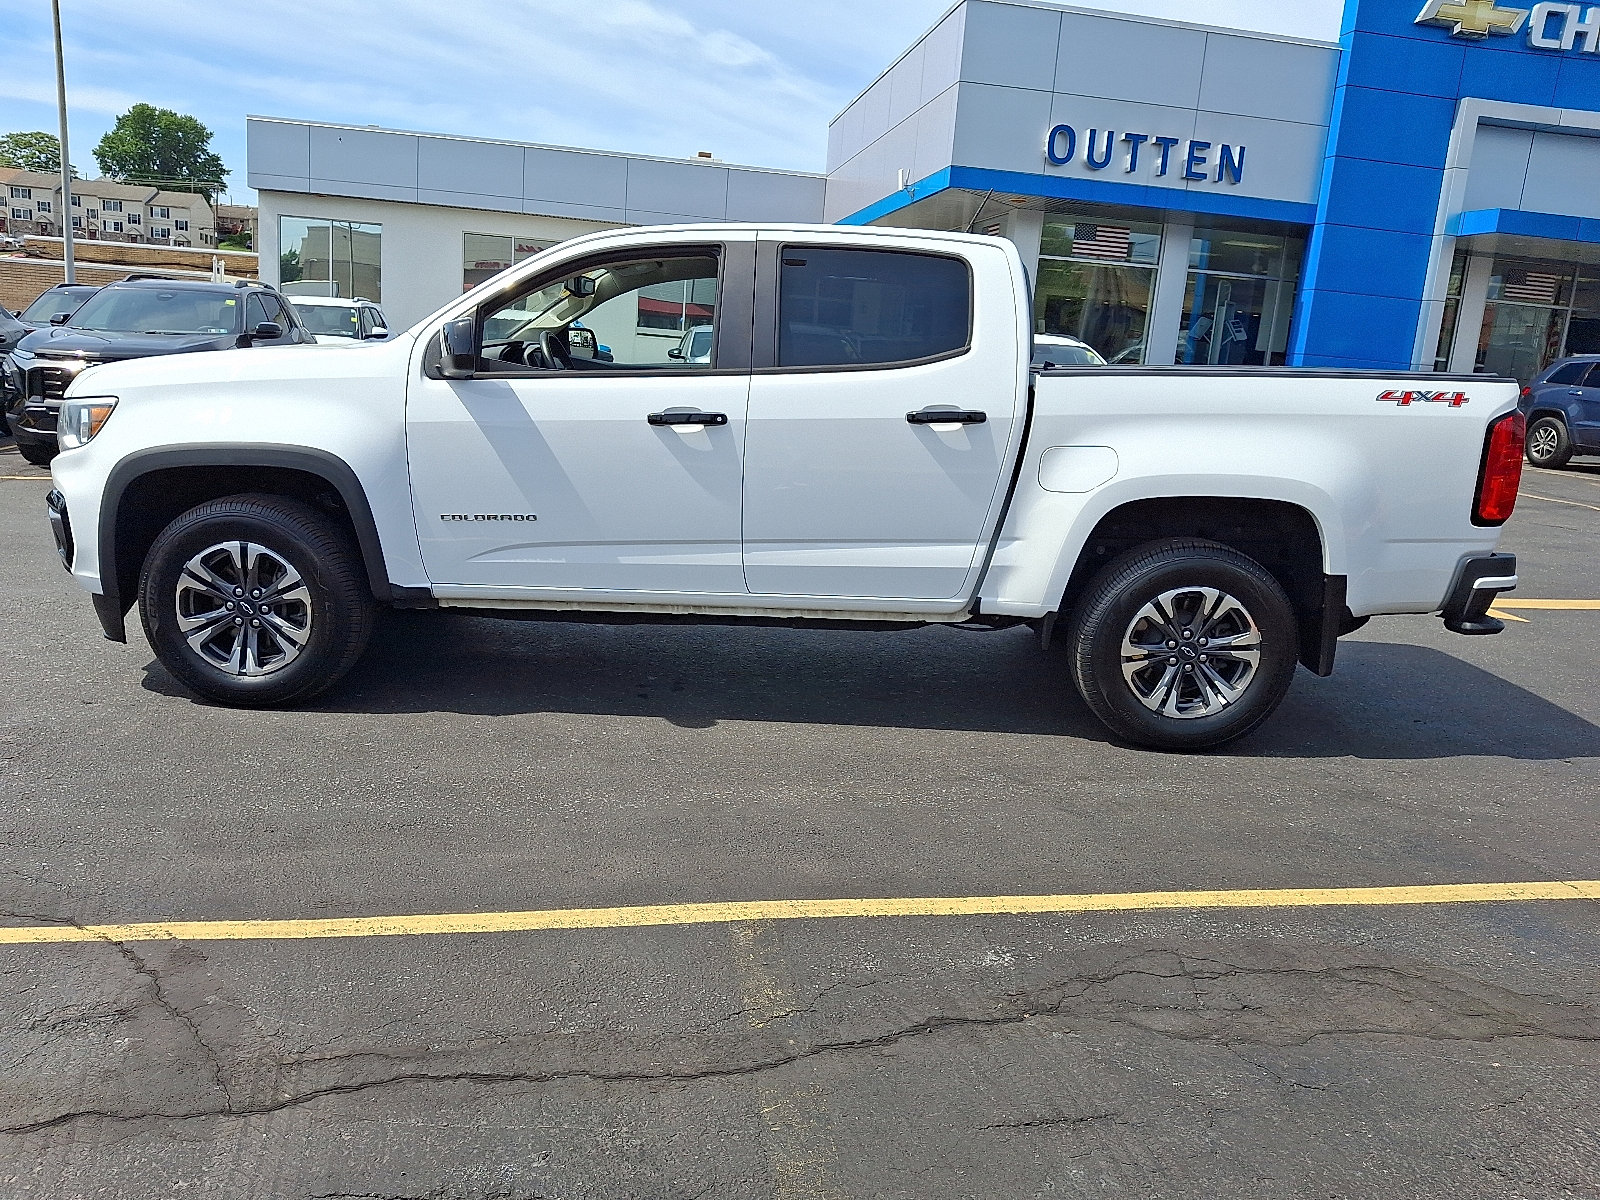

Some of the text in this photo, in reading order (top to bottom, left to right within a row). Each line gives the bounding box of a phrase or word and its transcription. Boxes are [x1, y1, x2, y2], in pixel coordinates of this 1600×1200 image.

[1529, 1, 1600, 52] CH
[1045, 123, 1246, 184] OUTTEN
[440, 513, 538, 522] COLORADO
